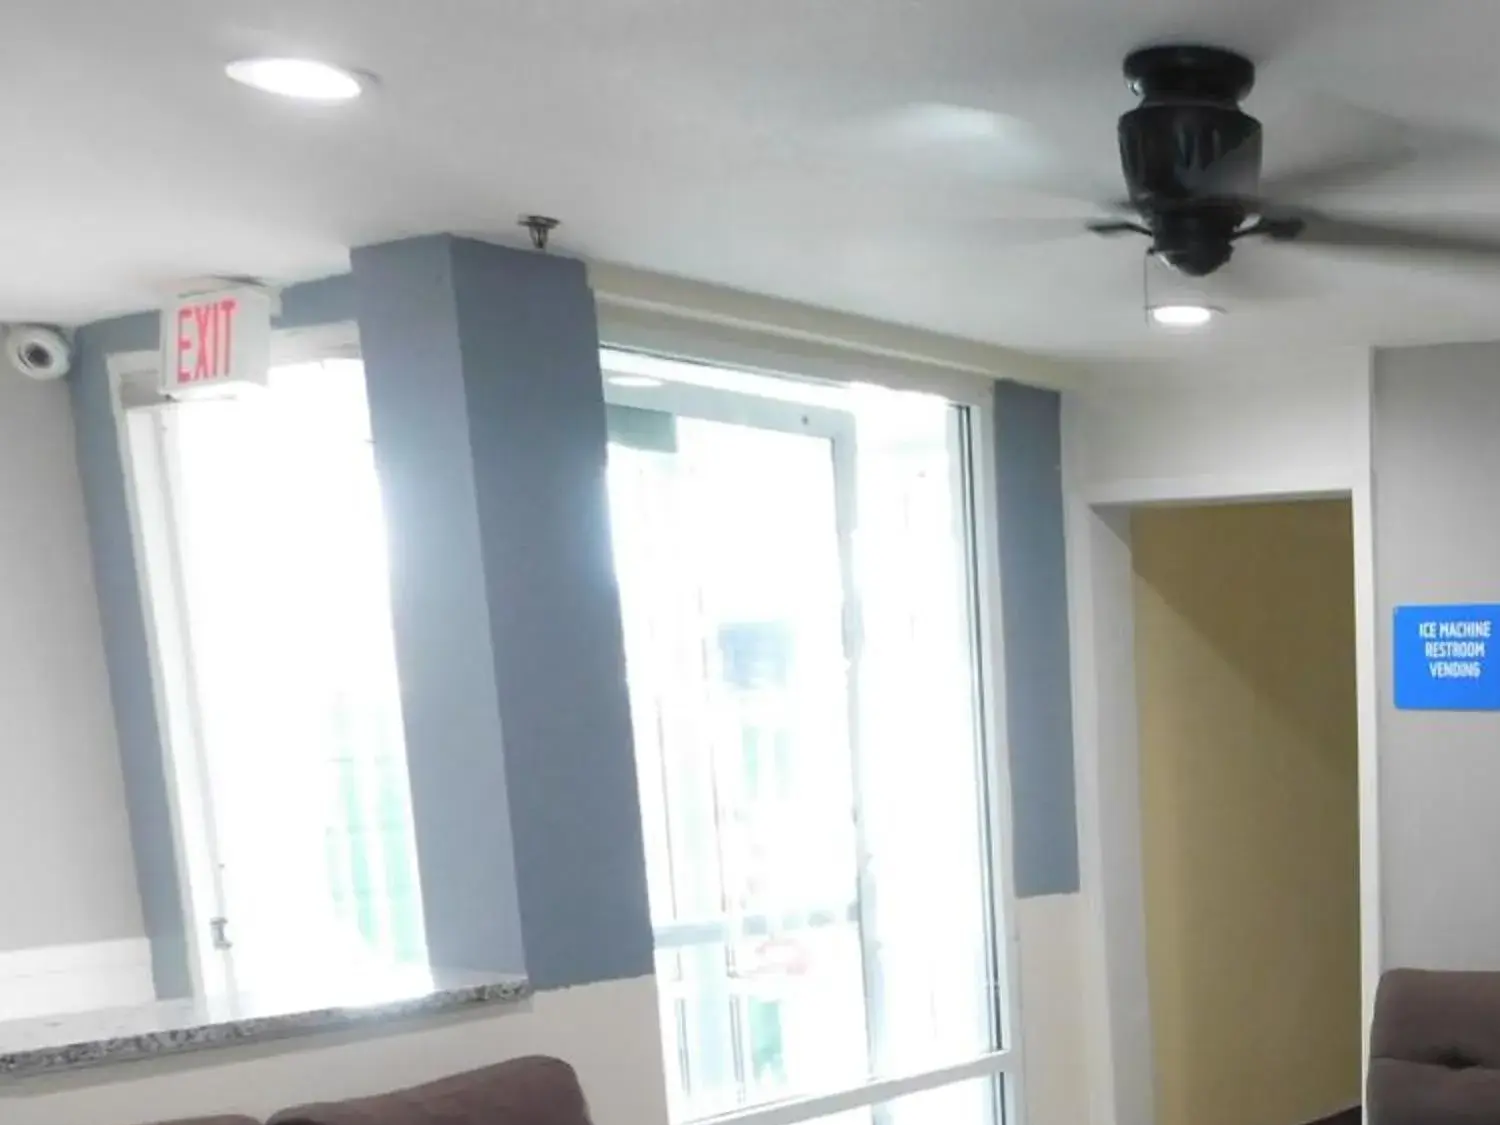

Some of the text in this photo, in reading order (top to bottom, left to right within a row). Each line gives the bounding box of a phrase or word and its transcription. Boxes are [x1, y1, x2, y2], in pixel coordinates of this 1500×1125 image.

[177, 299, 236, 383] EXIT
[1419, 620, 1492, 638] ICE MACHINE
[1425, 641, 1485, 657] RESTROOM
[1429, 661, 1481, 678] VENDING
